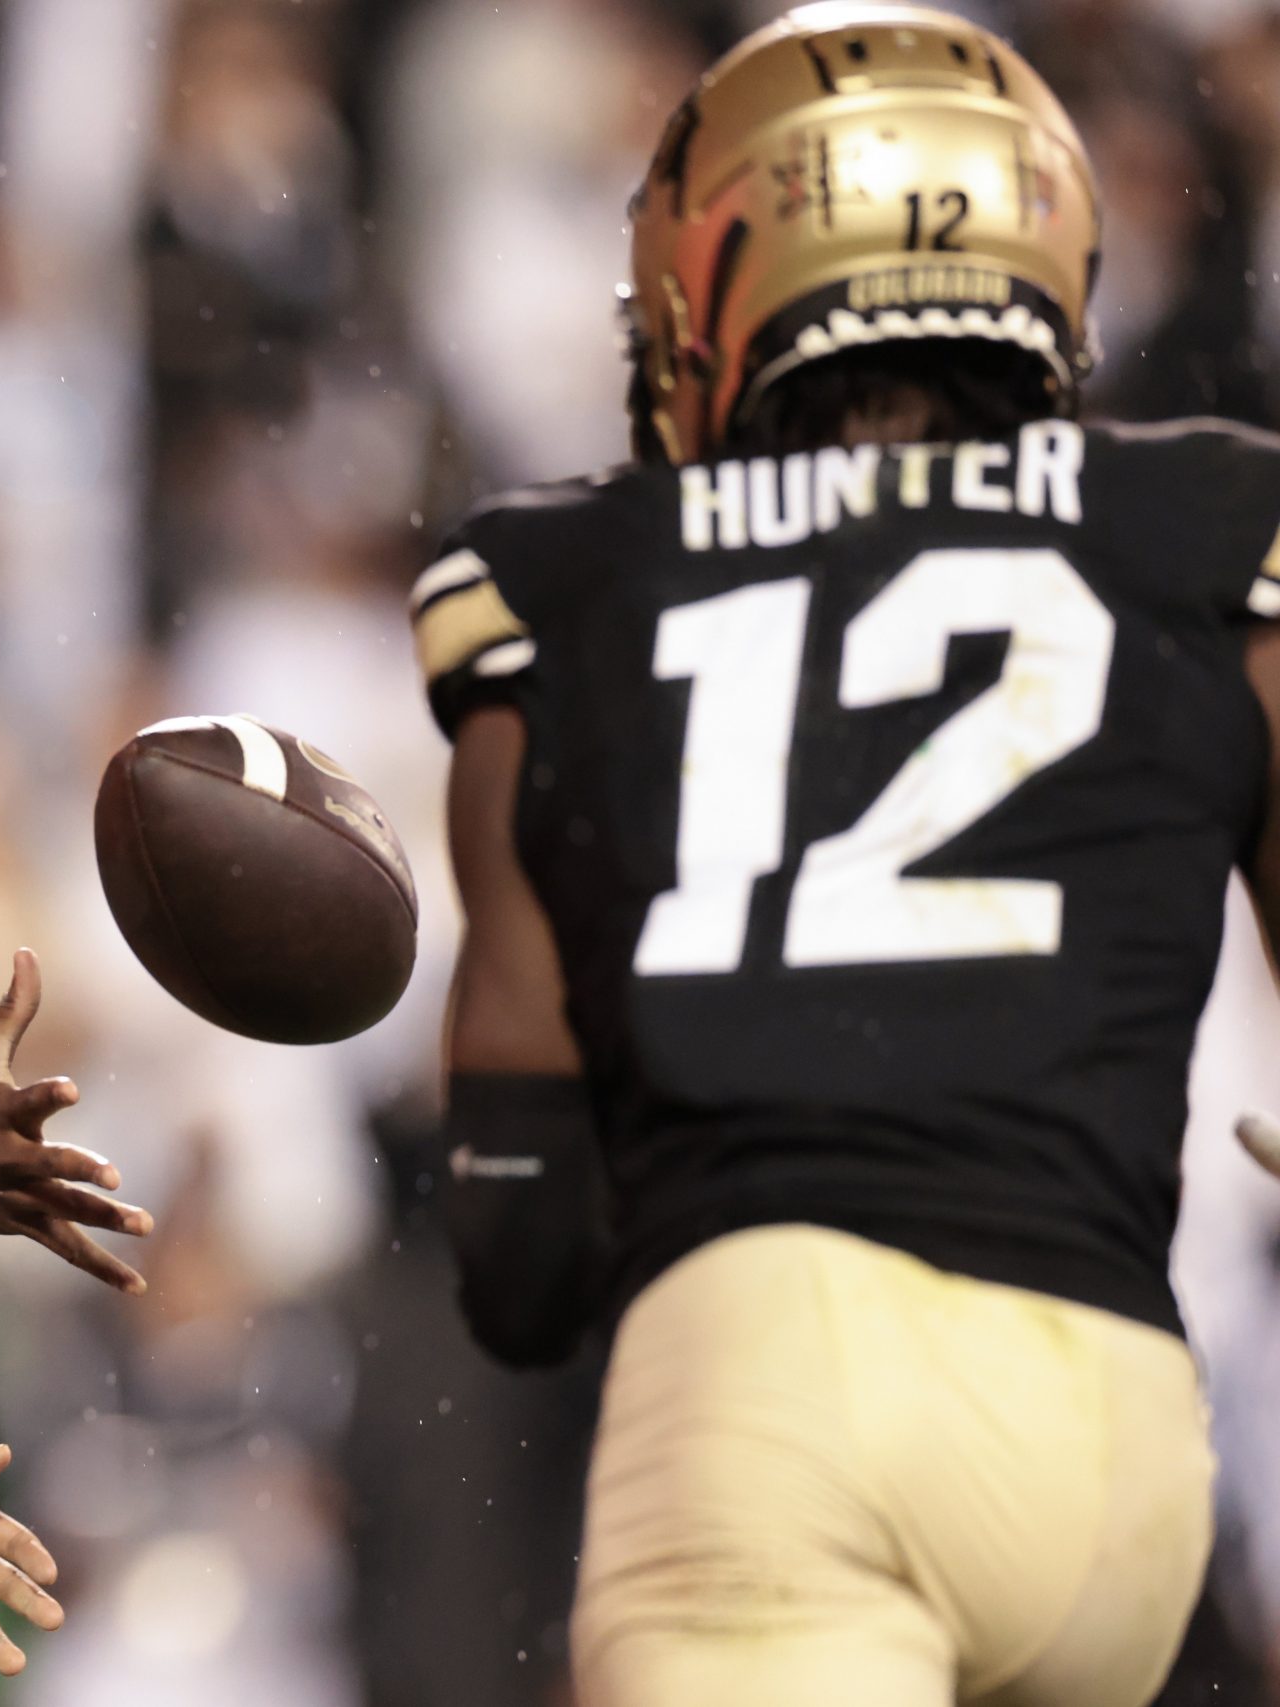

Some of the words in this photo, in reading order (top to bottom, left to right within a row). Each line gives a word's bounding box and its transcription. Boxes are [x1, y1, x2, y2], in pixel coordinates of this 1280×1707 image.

[902, 191, 969, 250] 12
[680, 418, 1085, 552] HUNTER
[632, 547, 1116, 976] 12
